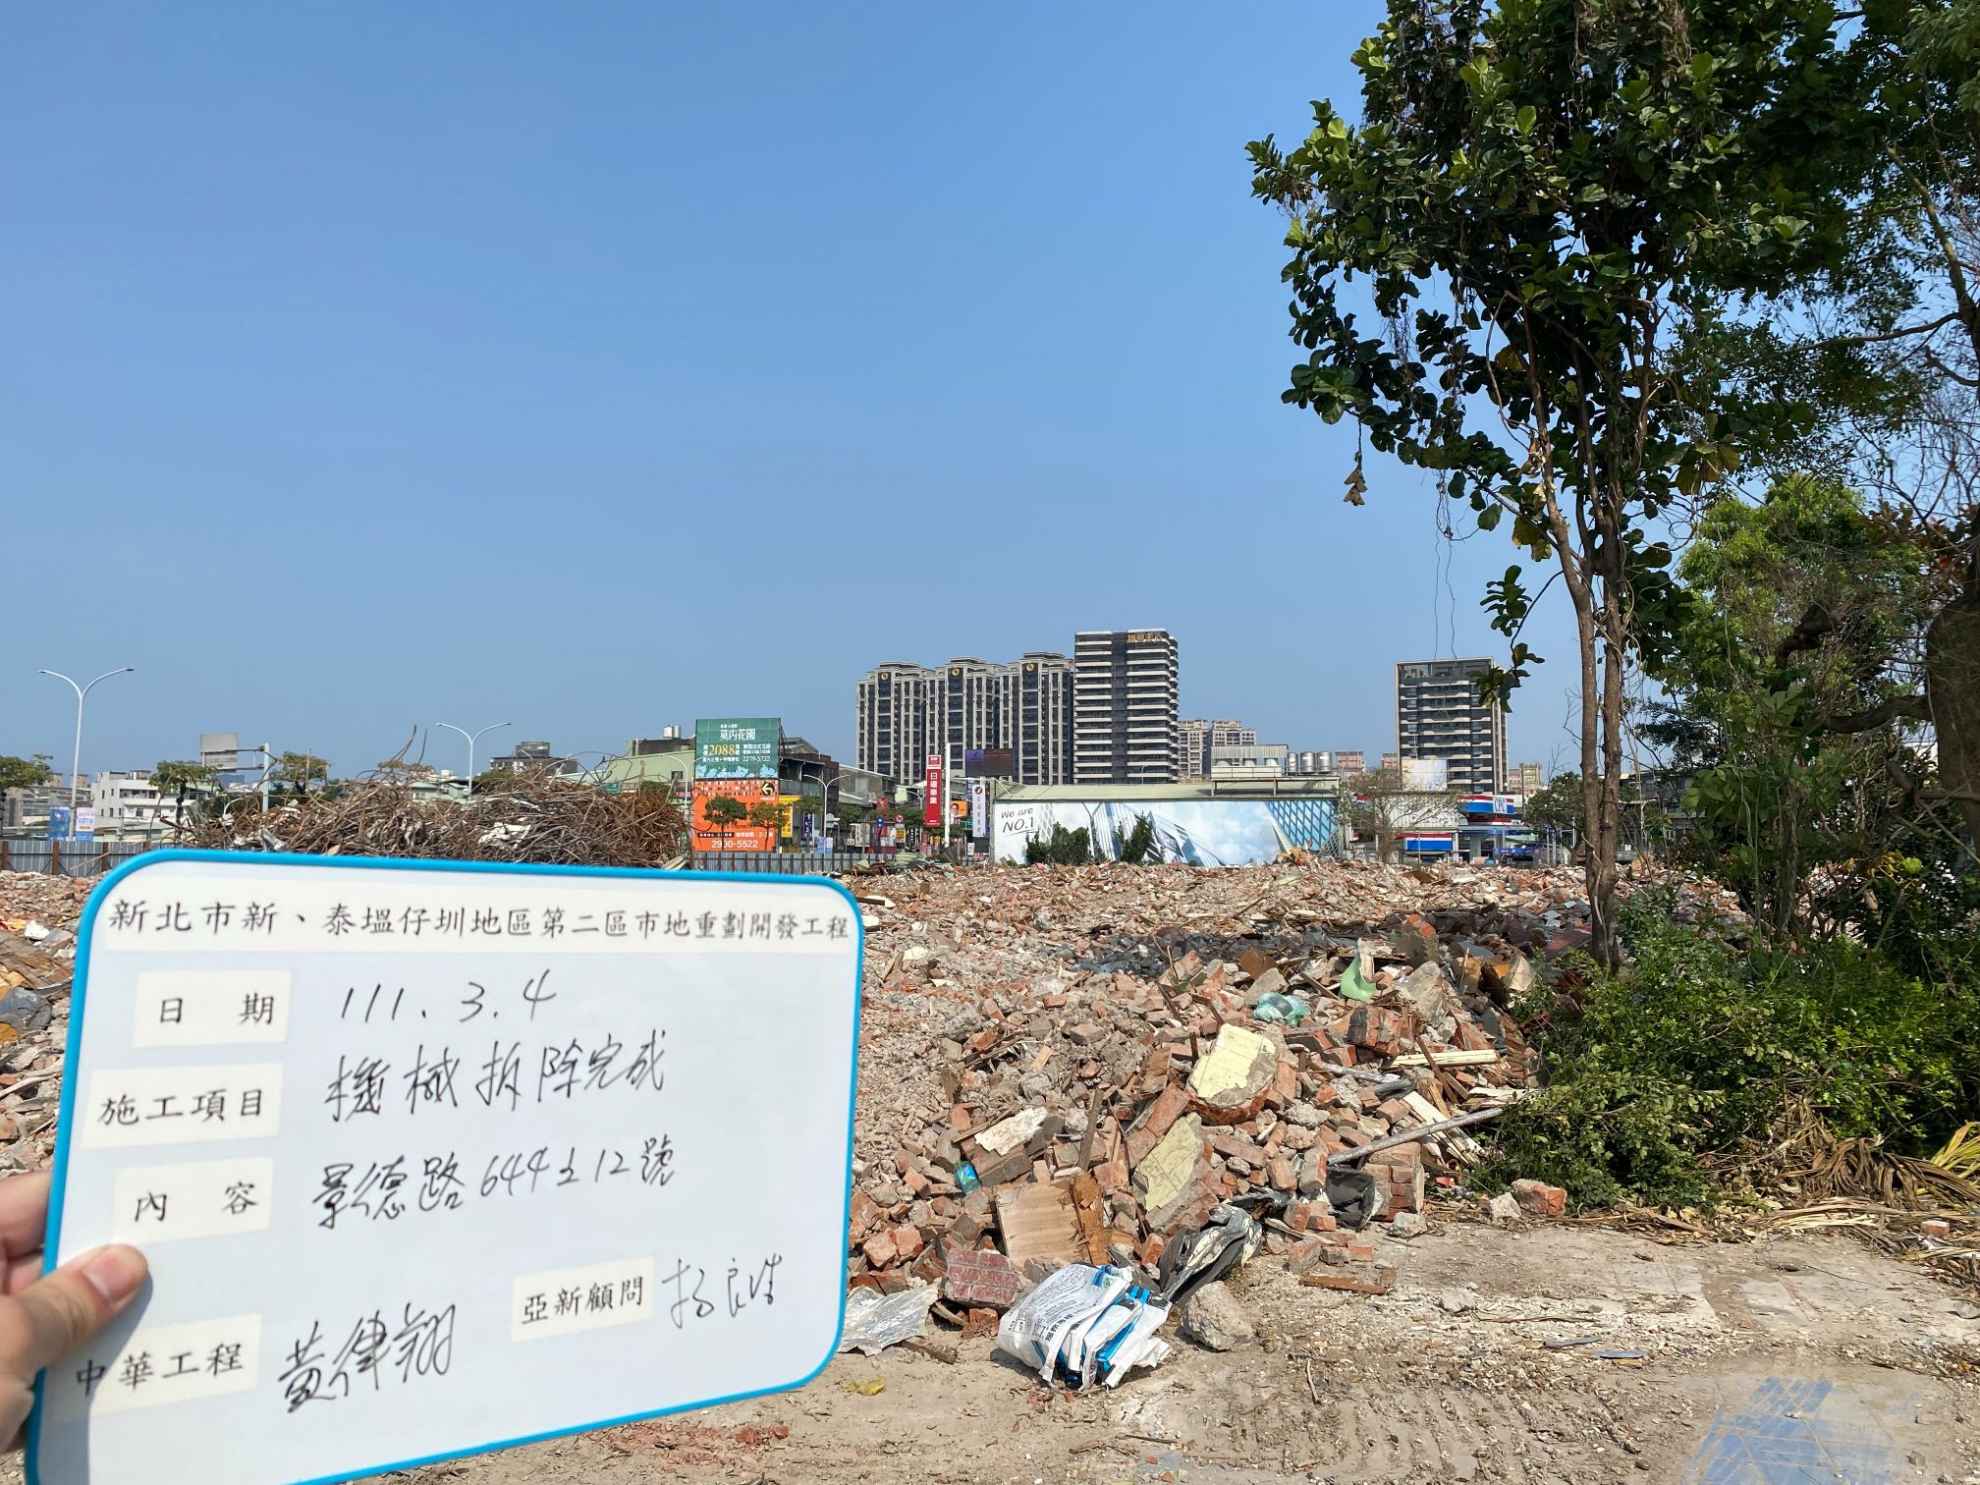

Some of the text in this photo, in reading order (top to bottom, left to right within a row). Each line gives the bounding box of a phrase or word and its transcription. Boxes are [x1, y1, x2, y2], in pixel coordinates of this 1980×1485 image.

[708, 743, 737, 756] 2088
[1001, 807, 1015, 818] We
[1002, 817, 1034, 833] NO.1
[108, 898, 849, 940] 新北市新、泰塭仔圳地區第二區市地重劃開發工程
[159, 993, 275, 1026] 日期
[97, 1087, 265, 1126] 施工項目
[521, 1274, 645, 1325] 亞新顧問
[75, 1339, 245, 1395] 中華工程
